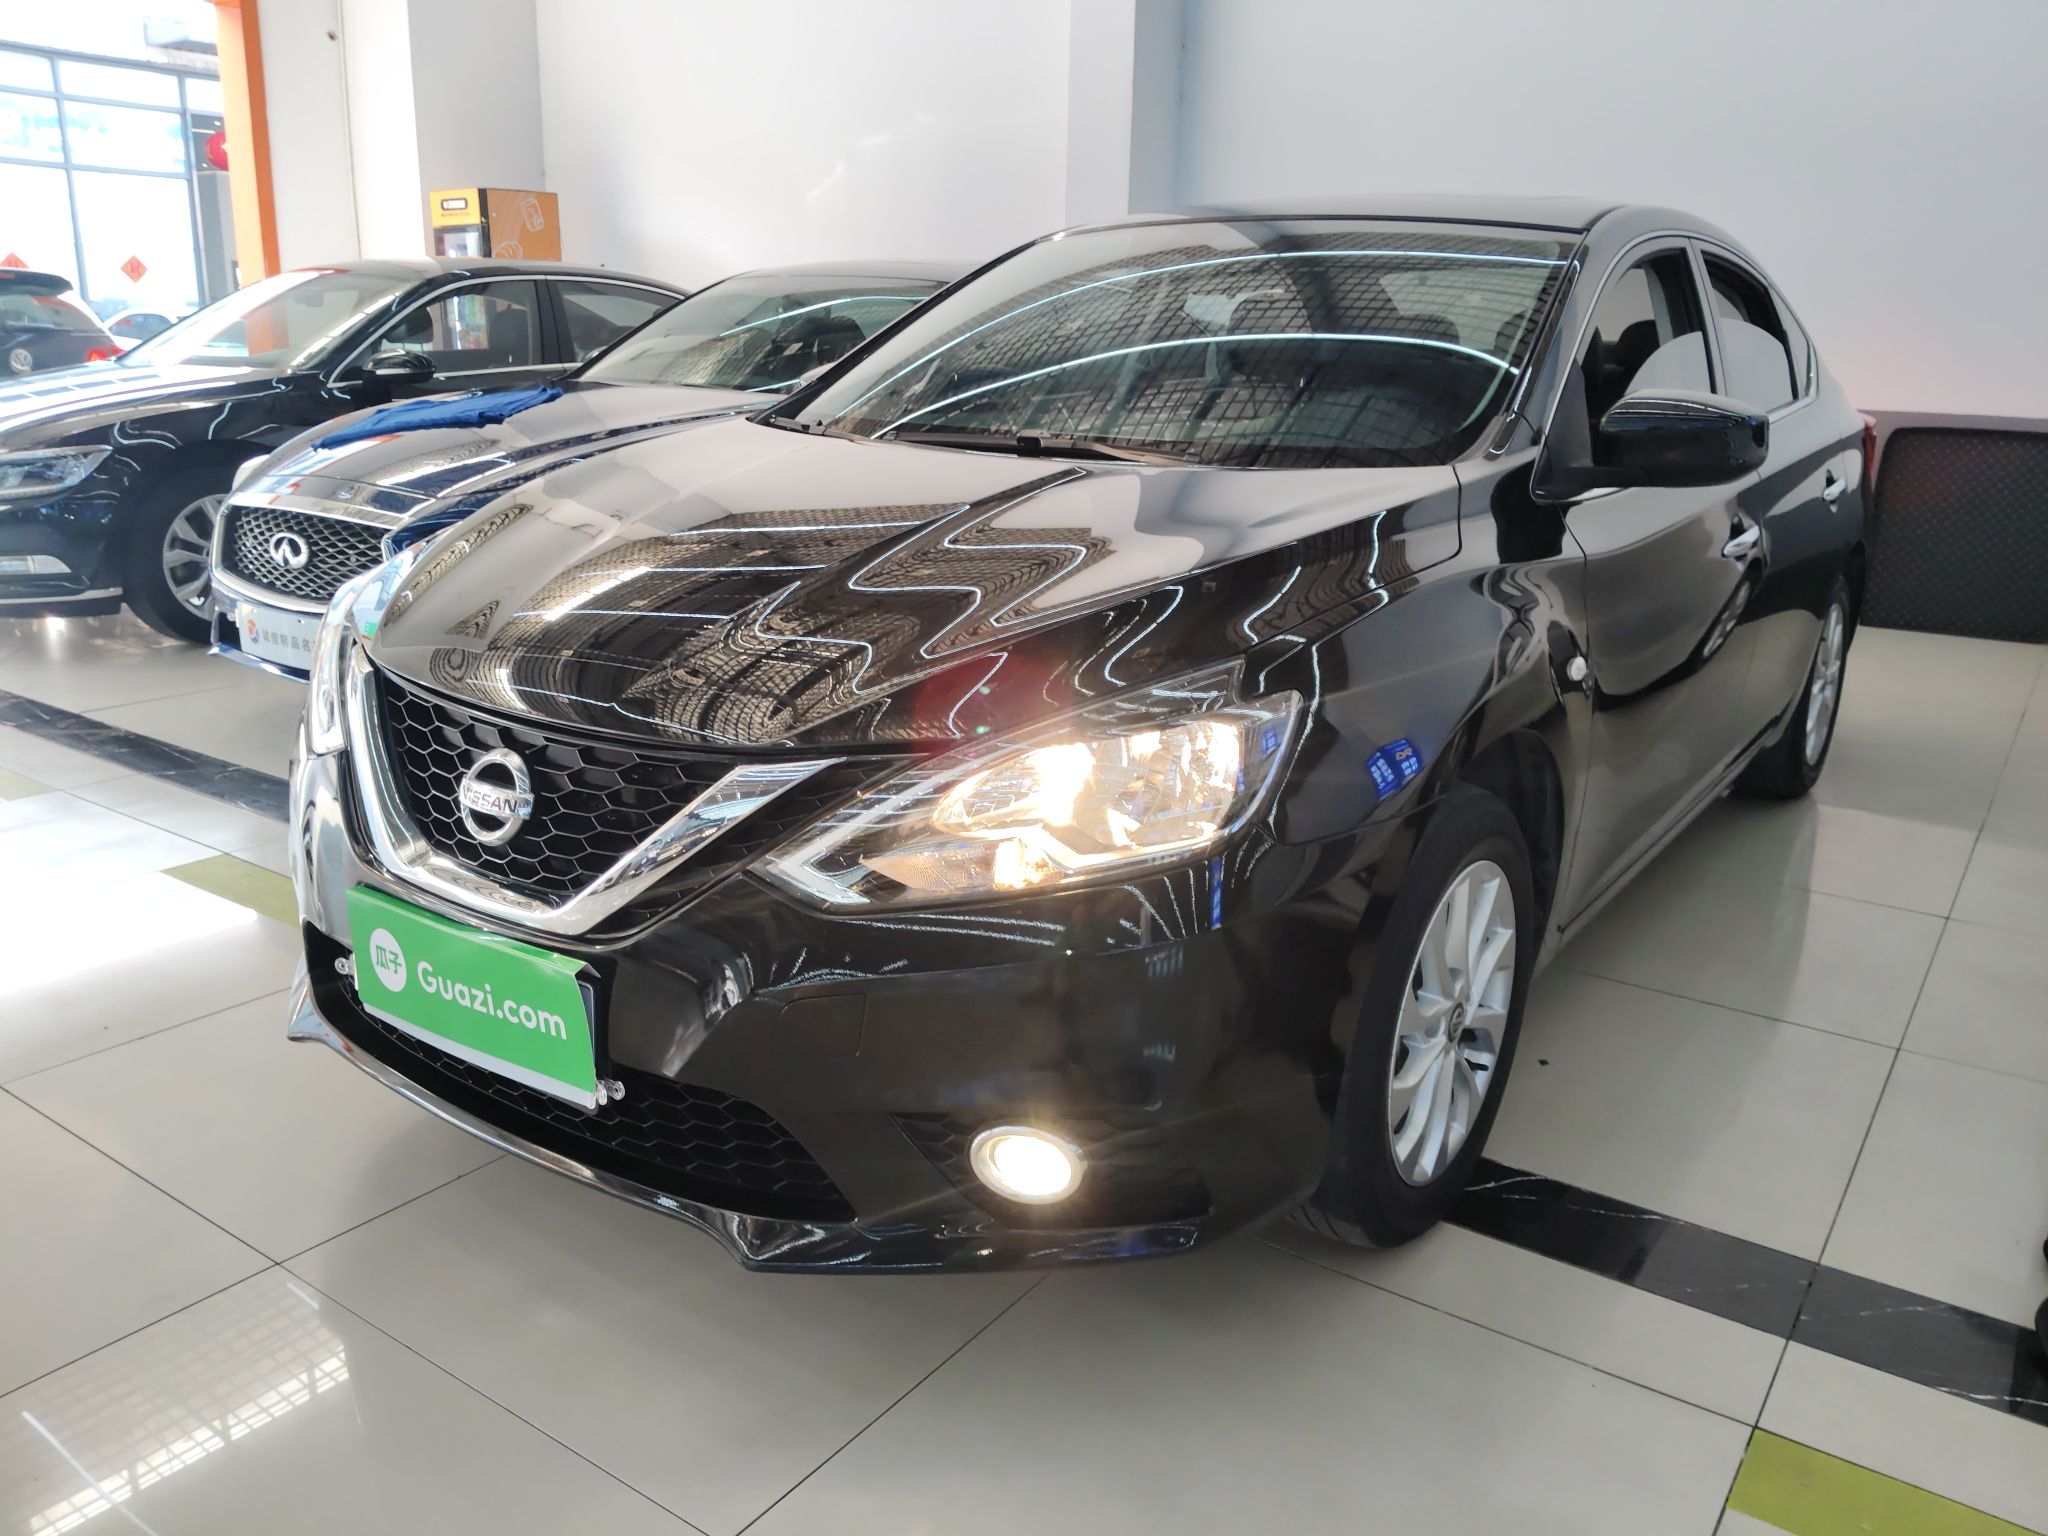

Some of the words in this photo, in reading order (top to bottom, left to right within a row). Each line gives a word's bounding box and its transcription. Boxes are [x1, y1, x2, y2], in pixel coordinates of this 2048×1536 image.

[462, 782, 518, 813] NISSAN
[375, 945, 403, 974] 瓜子
[417, 961, 568, 1040] Guazi.com
